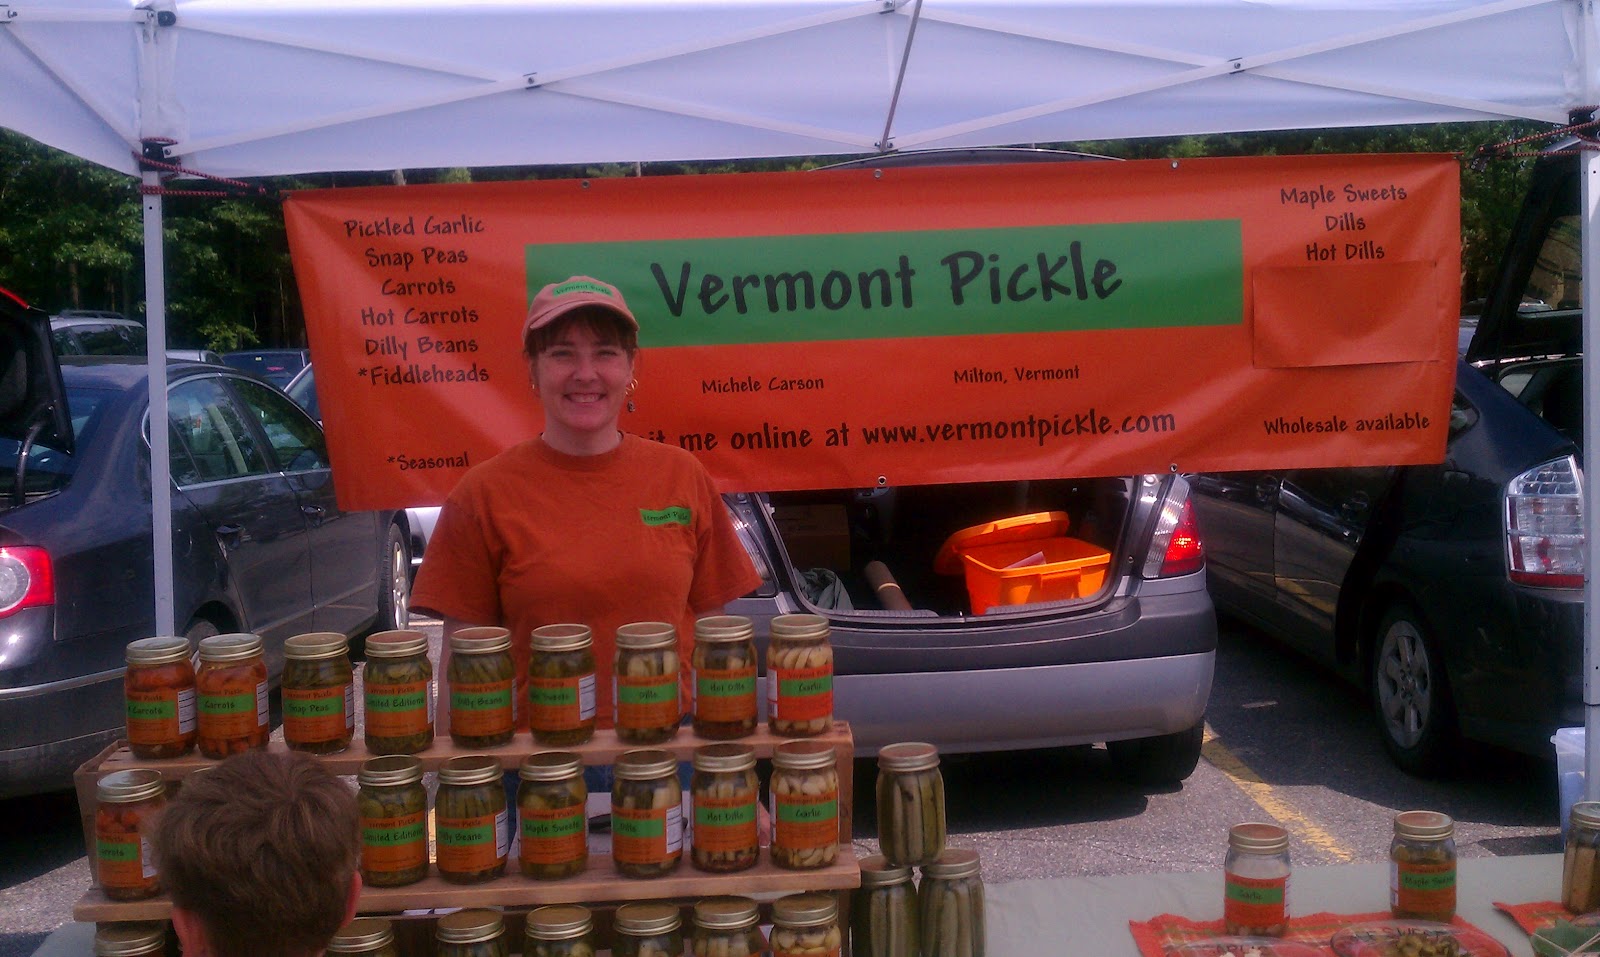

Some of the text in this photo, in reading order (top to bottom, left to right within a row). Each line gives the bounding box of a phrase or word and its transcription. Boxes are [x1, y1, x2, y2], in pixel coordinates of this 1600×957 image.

[1280, 183, 1407, 209] Maple Sweets
[344, 214, 485, 238] Pickled Garlic
[1325, 212, 1366, 231] Dills
[365, 246, 468, 270] Snap Peas
[1306, 240, 1385, 261] Hot Dills
[381, 277, 456, 297] Carrots
[650, 240, 1123, 317] Vermont Pickle
[361, 306, 479, 327] Hot Carrots
[365, 336, 479, 360] Dilly Beans
[954, 364, 1080, 384] Milton, Vermont
[702, 376, 825, 394] Michele Carson
[679, 430, 719, 452] me
[730, 422, 813, 450] online
[825, 422, 850, 447] at
[862, 408, 1176, 446] www.vermontpickle.com
[1264, 412, 1431, 436] Wholesale available
[710, 683, 745, 692] Hot Dills
[798, 682, 822, 692] Garlic
[131, 705, 163, 715] Carrots
[204, 700, 236, 710] Carrots
[288, 702, 330, 716] Snap Peas
[707, 811, 721, 822] Hot
[795, 808, 822, 818] Garlic
[455, 832, 482, 842] Beans
[525, 820, 580, 835] Maple Sweets
